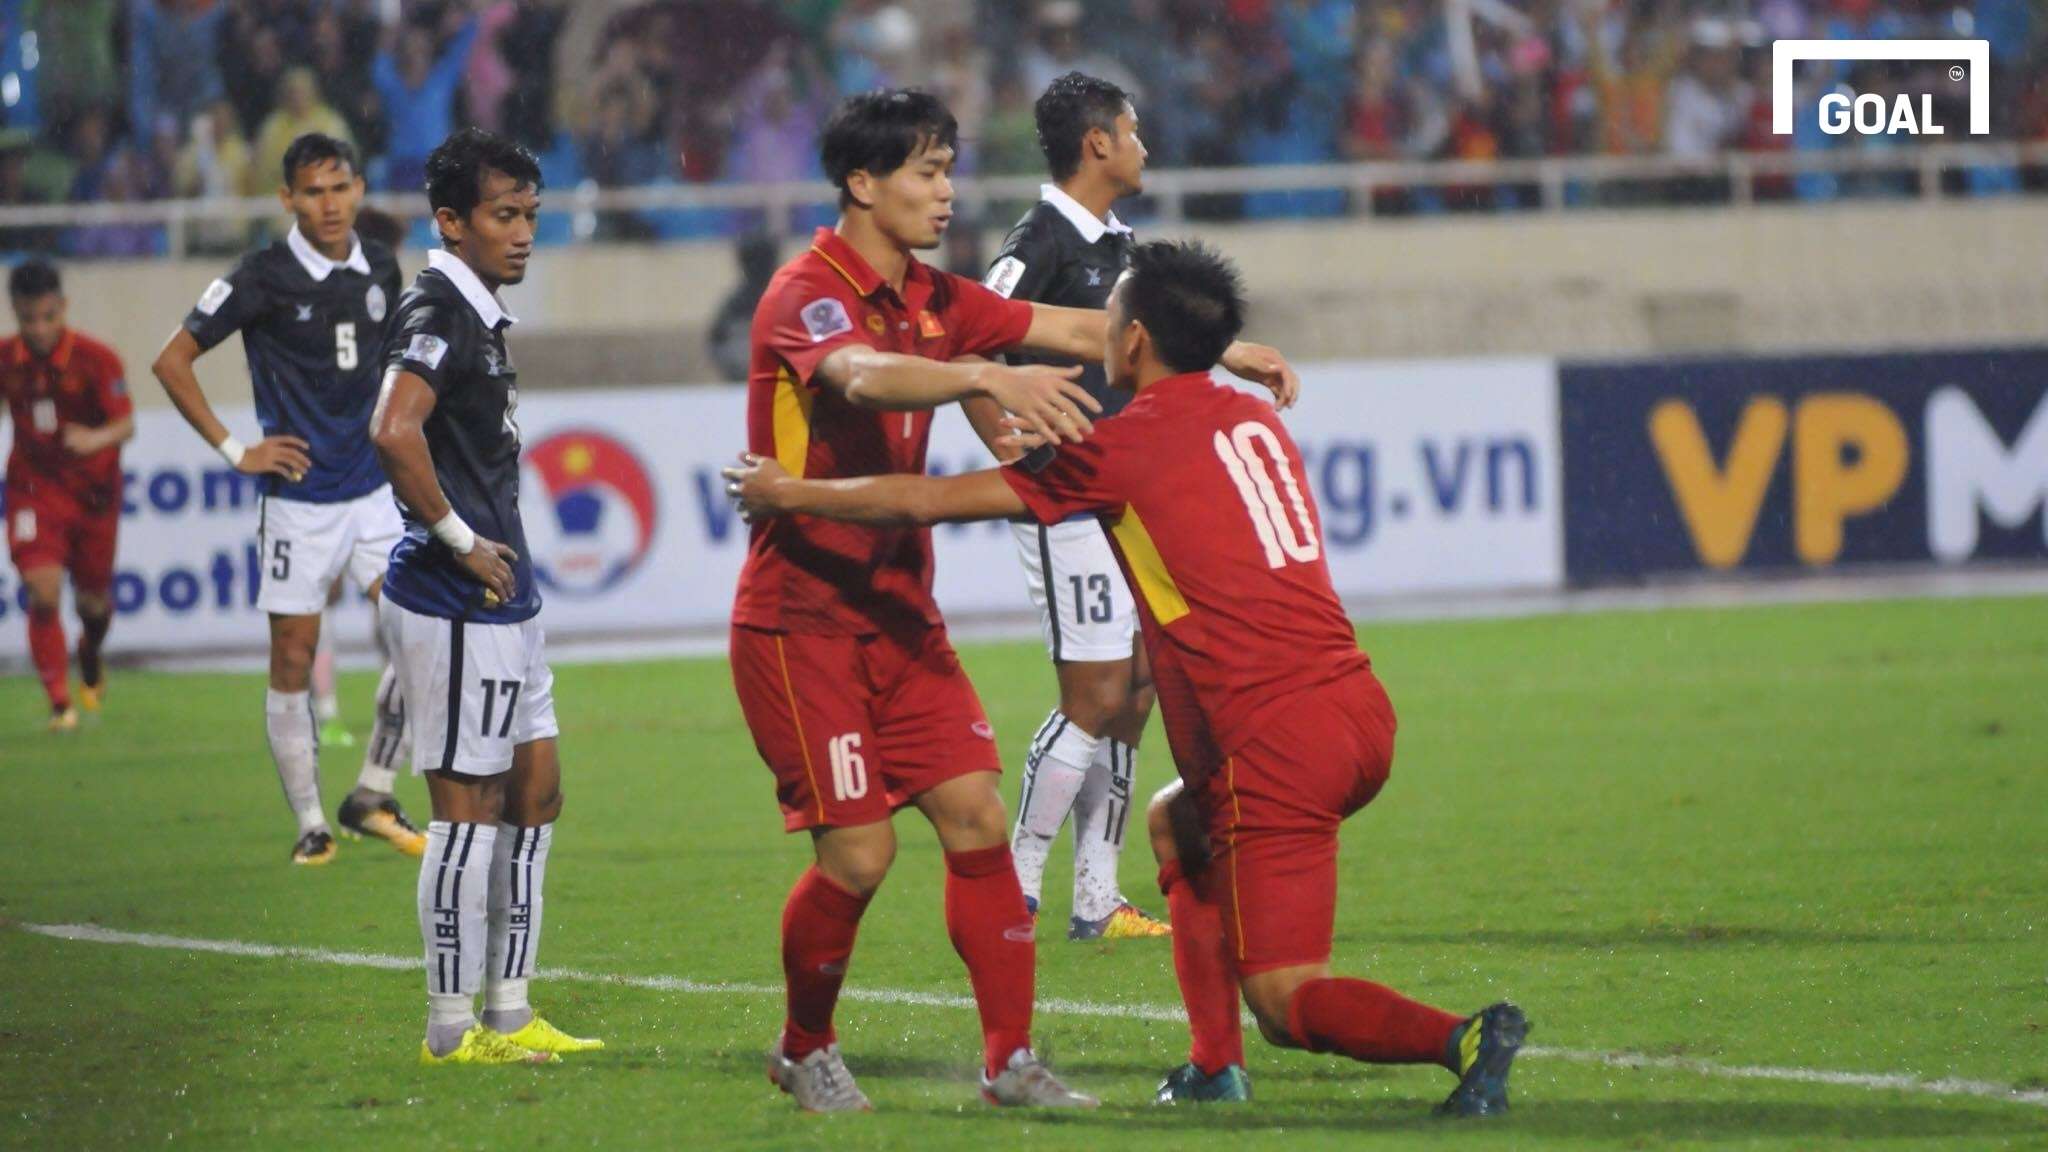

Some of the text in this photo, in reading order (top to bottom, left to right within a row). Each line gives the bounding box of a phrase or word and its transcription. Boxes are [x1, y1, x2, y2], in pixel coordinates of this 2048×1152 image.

[335, 322, 358, 371] 5
[1213, 420, 1320, 569] 10
[272, 540, 292, 581] 5
[1069, 573, 1112, 626] 13
[480, 678, 521, 738] 17
[828, 732, 868, 801] 16
[434, 908, 461, 954] FBT
